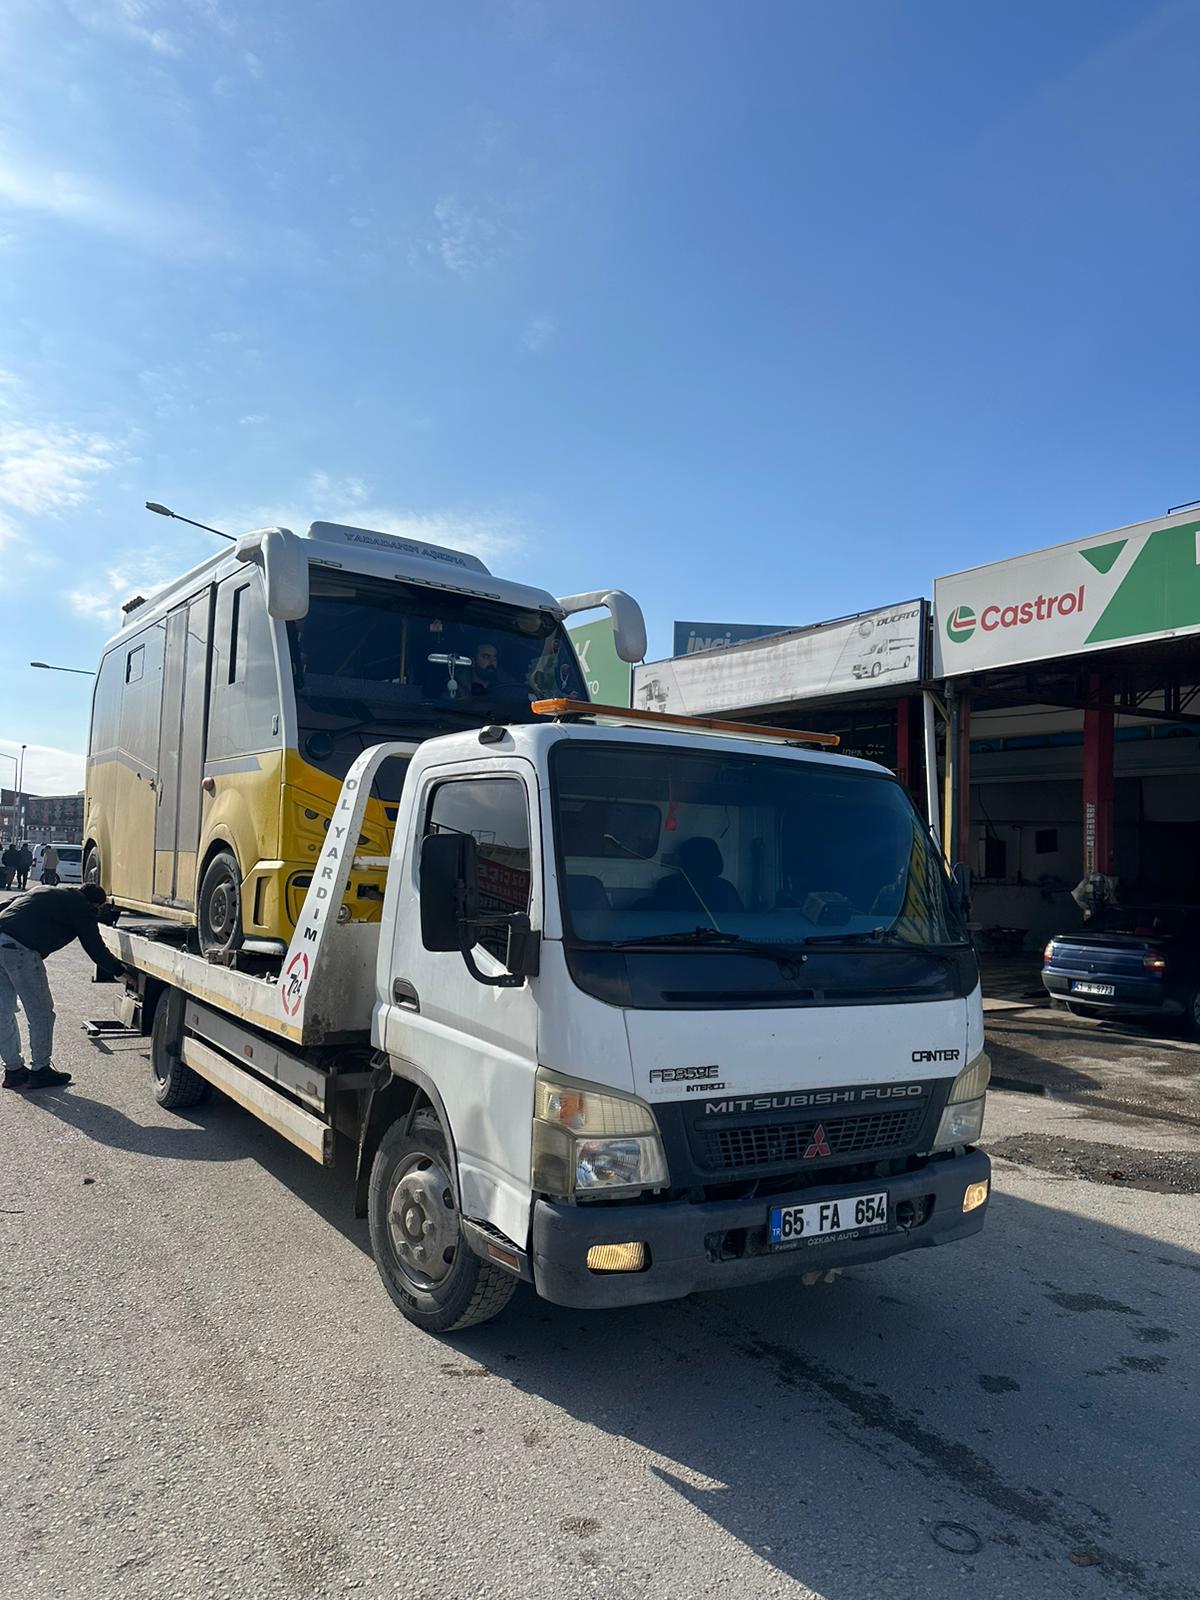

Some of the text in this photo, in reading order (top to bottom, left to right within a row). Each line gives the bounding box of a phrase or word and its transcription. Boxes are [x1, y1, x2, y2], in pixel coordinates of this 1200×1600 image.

[876, 609, 920, 627] DUCATO
[980, 584, 1085, 632] Castrol
[303, 826, 346, 942] YARDIM
[911, 1049, 960, 1063] CANTER
[705, 1091, 855, 1114] MITSUBISHI
[861, 1085, 923, 1100] FUSO
[772, 1196, 886, 1238] TR 65 FA 654
[838, 1230, 860, 1241] AUTO
